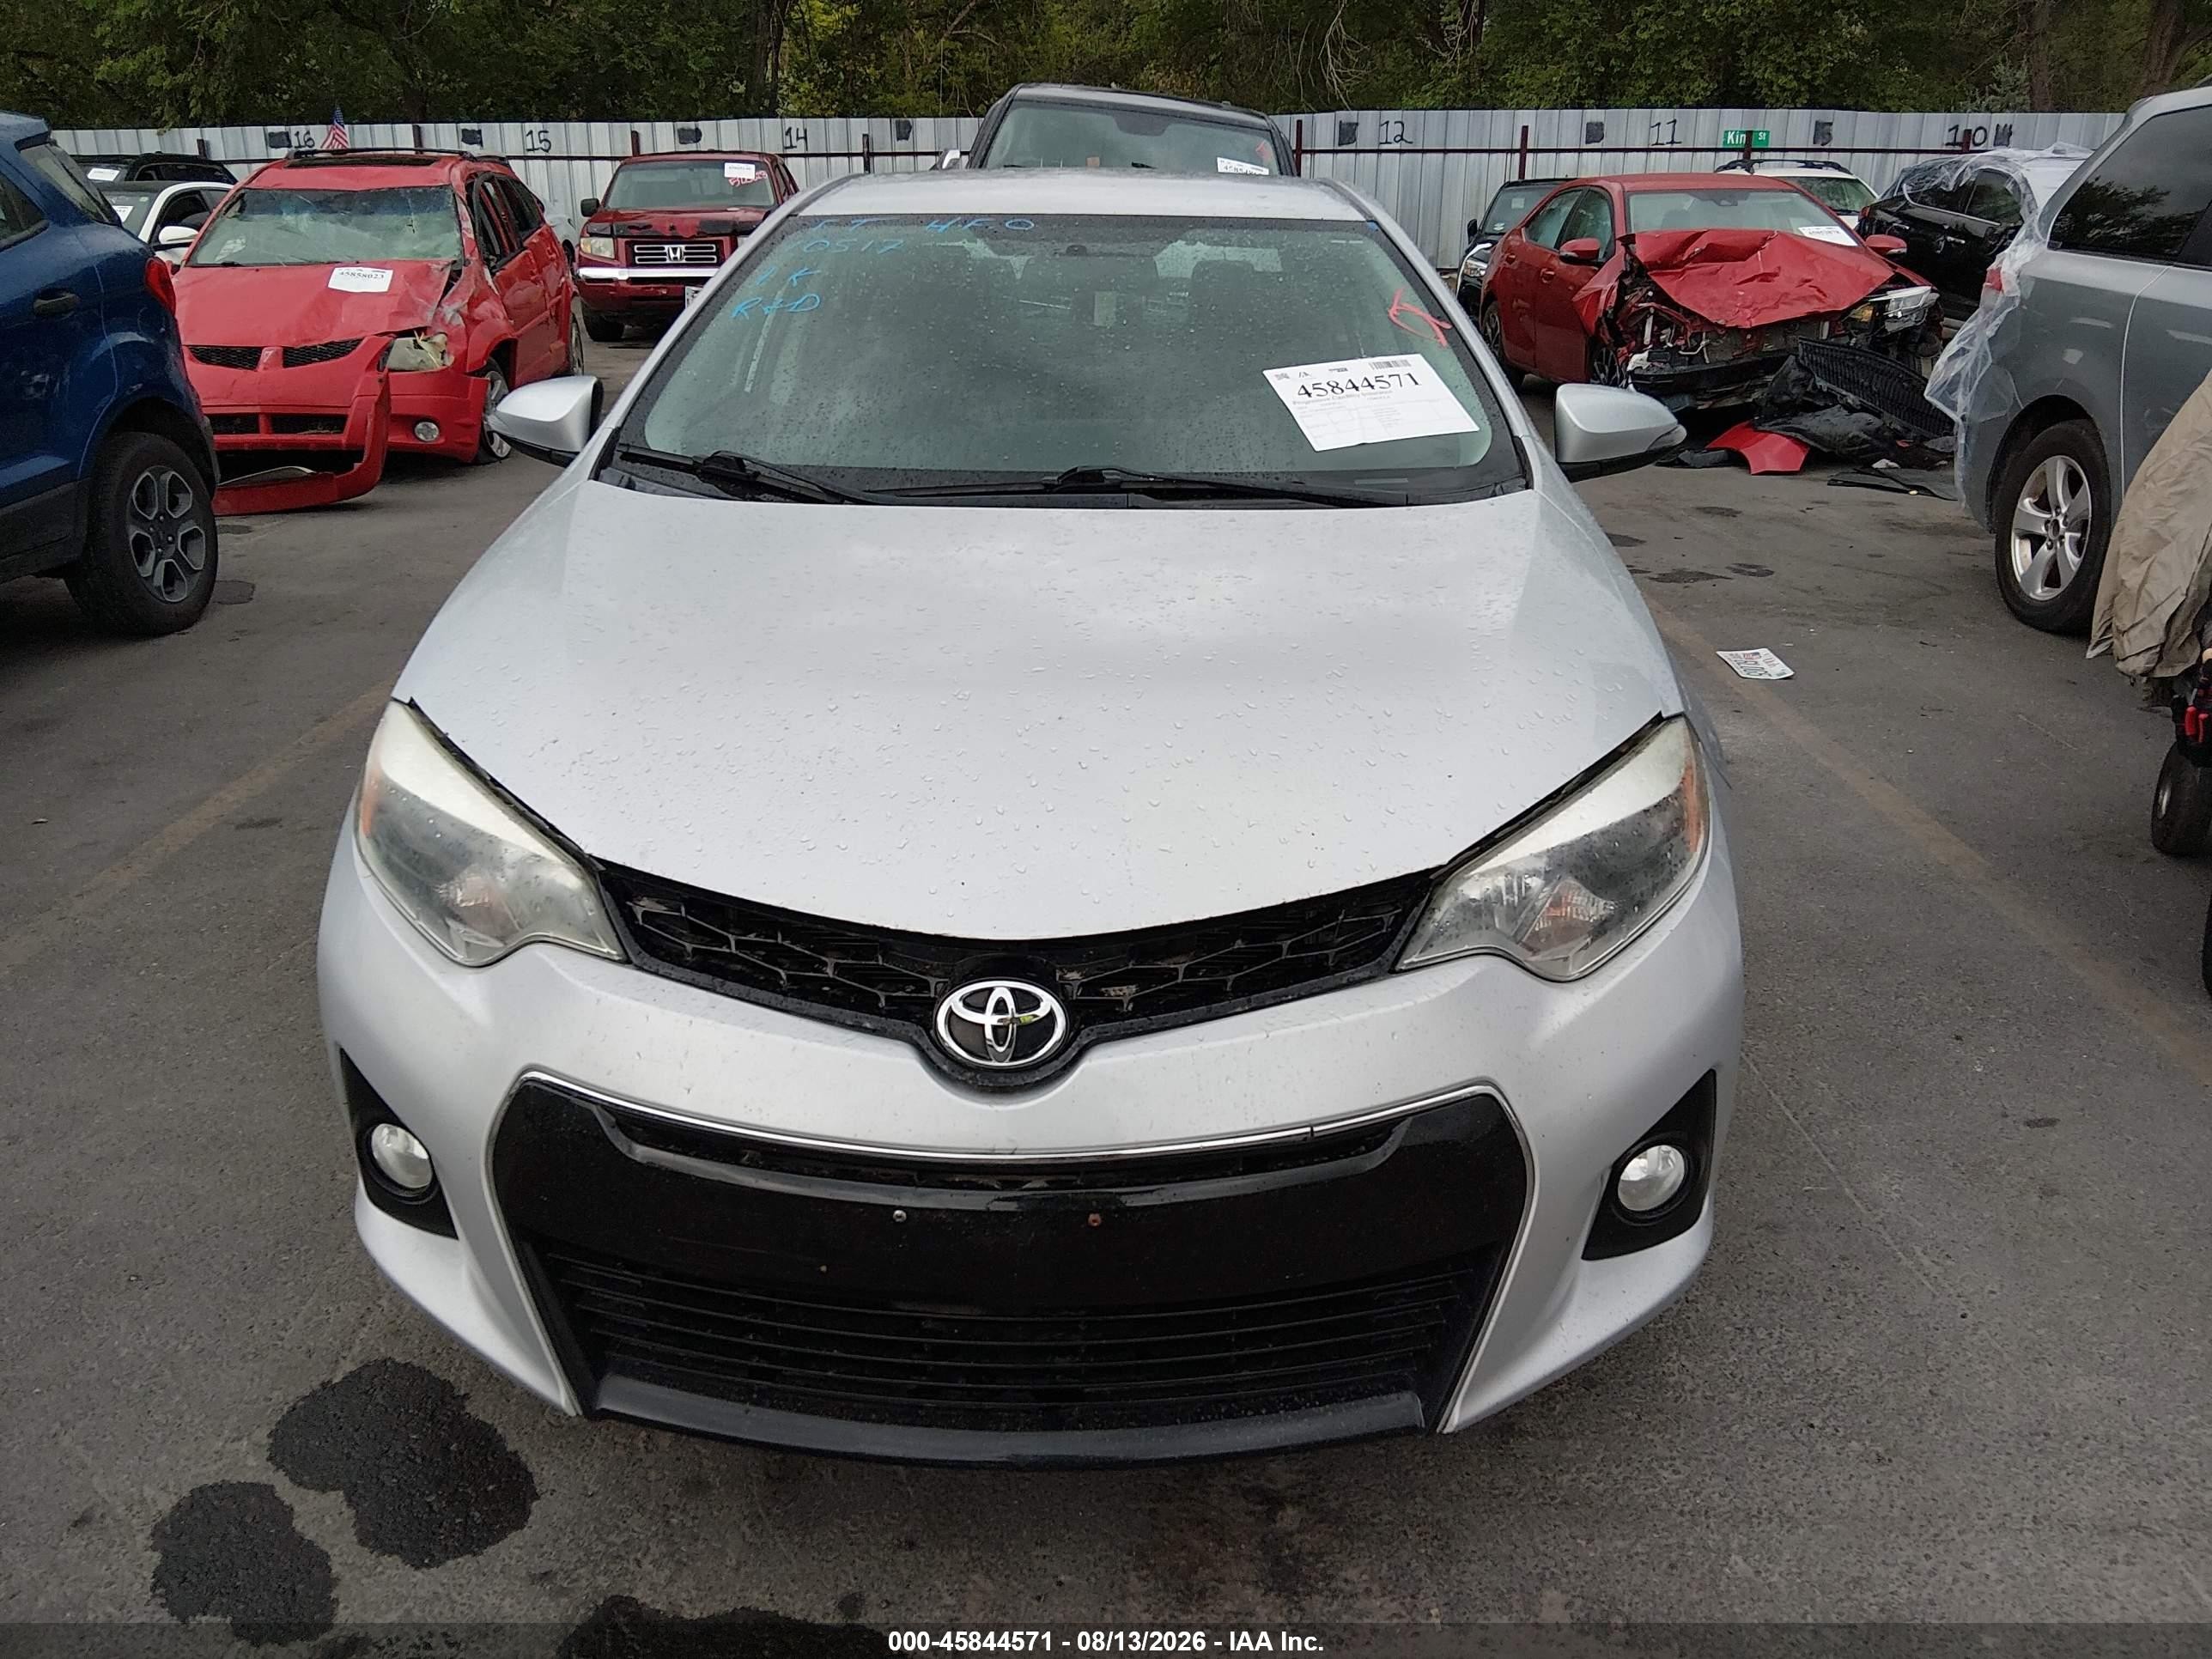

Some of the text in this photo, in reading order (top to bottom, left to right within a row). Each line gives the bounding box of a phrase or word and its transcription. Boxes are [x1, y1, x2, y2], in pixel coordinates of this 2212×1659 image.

[294, 130, 315, 149] 16
[526, 129, 552, 153] 15
[784, 126, 808, 152] 14
[1379, 120, 1413, 144] 12
[1650, 118, 1682, 146] 11
[1726, 131, 1766, 145] Kin St
[1945, 124, 1988, 147] 10
[1297, 373, 1420, 398] 45844571
